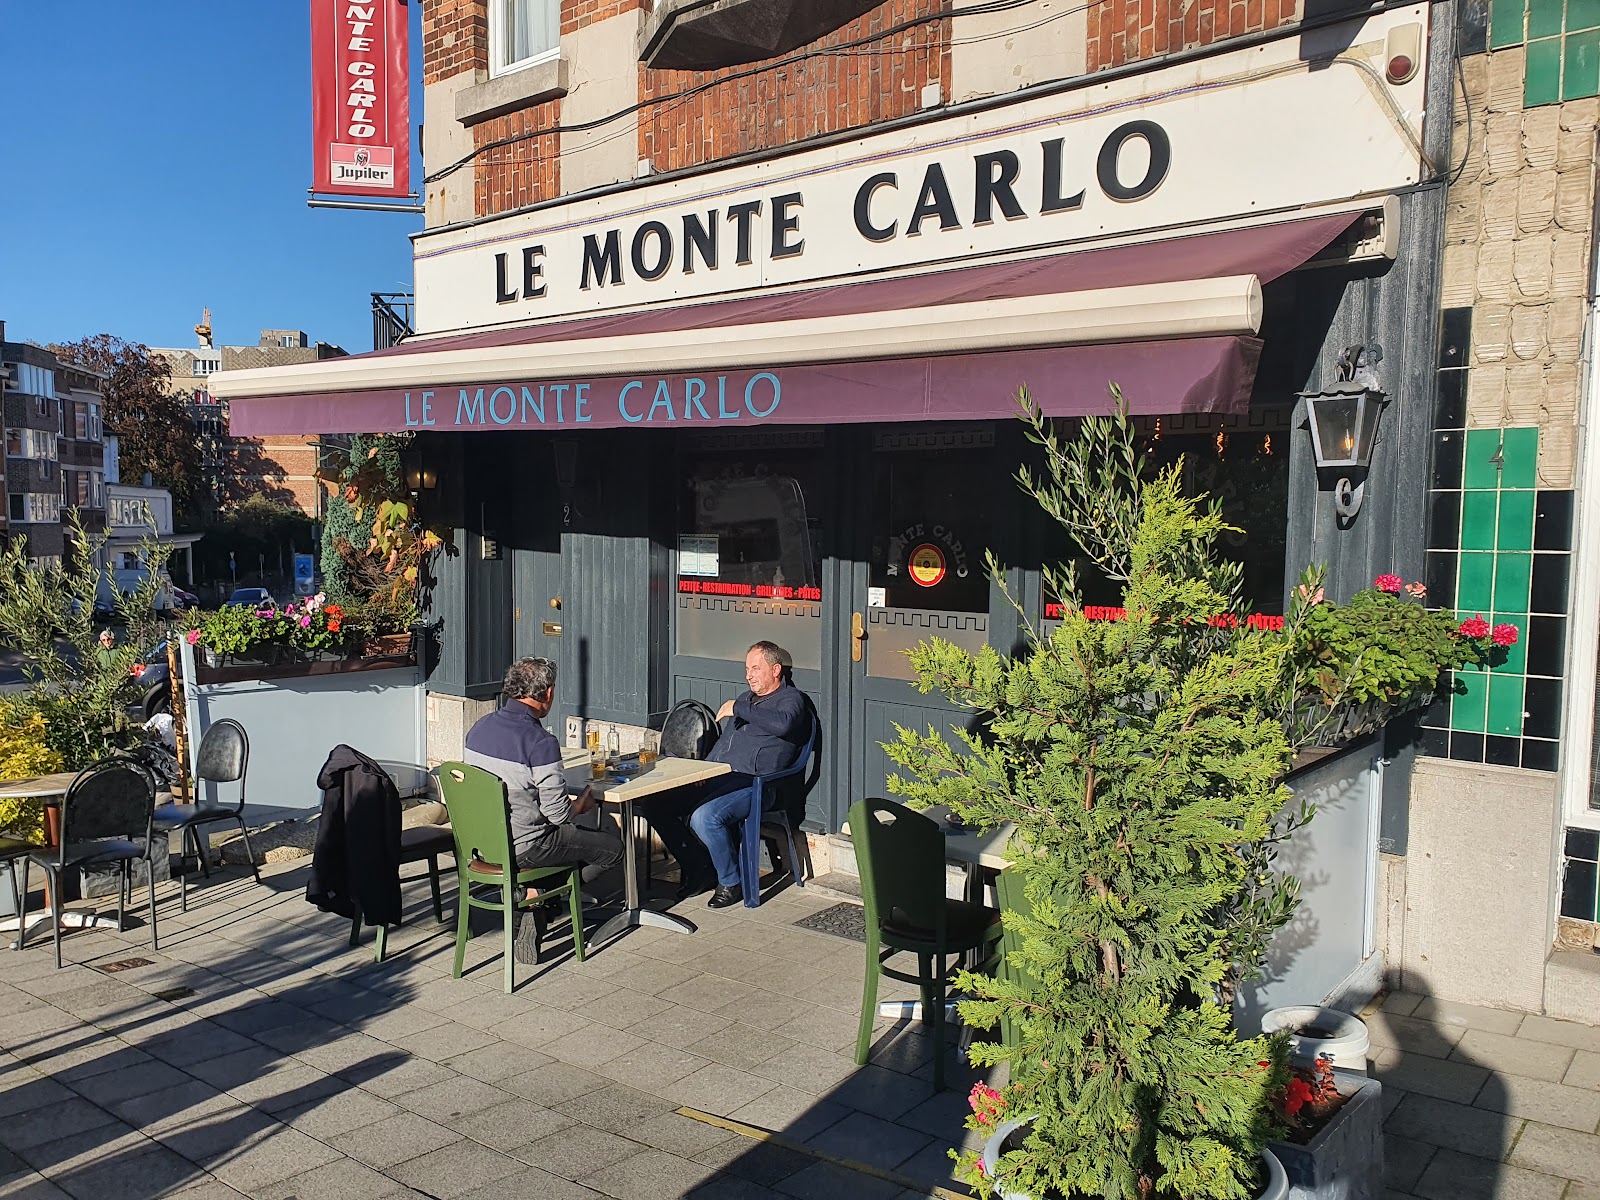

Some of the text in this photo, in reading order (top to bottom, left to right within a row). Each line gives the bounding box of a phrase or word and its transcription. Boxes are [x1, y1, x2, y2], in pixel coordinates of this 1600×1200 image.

[346, 0, 377, 138] NTE CARLO
[336, 165, 389, 181] Jupiler
[494, 119, 1172, 304] LE MONTE CARLO
[405, 373, 783, 426] LE MONTE CARLO
[1488, 444, 1505, 470] 4
[563, 504, 571, 524] 2
[932, 525, 969, 578] CARLO
[569, 722, 577, 739] 2
